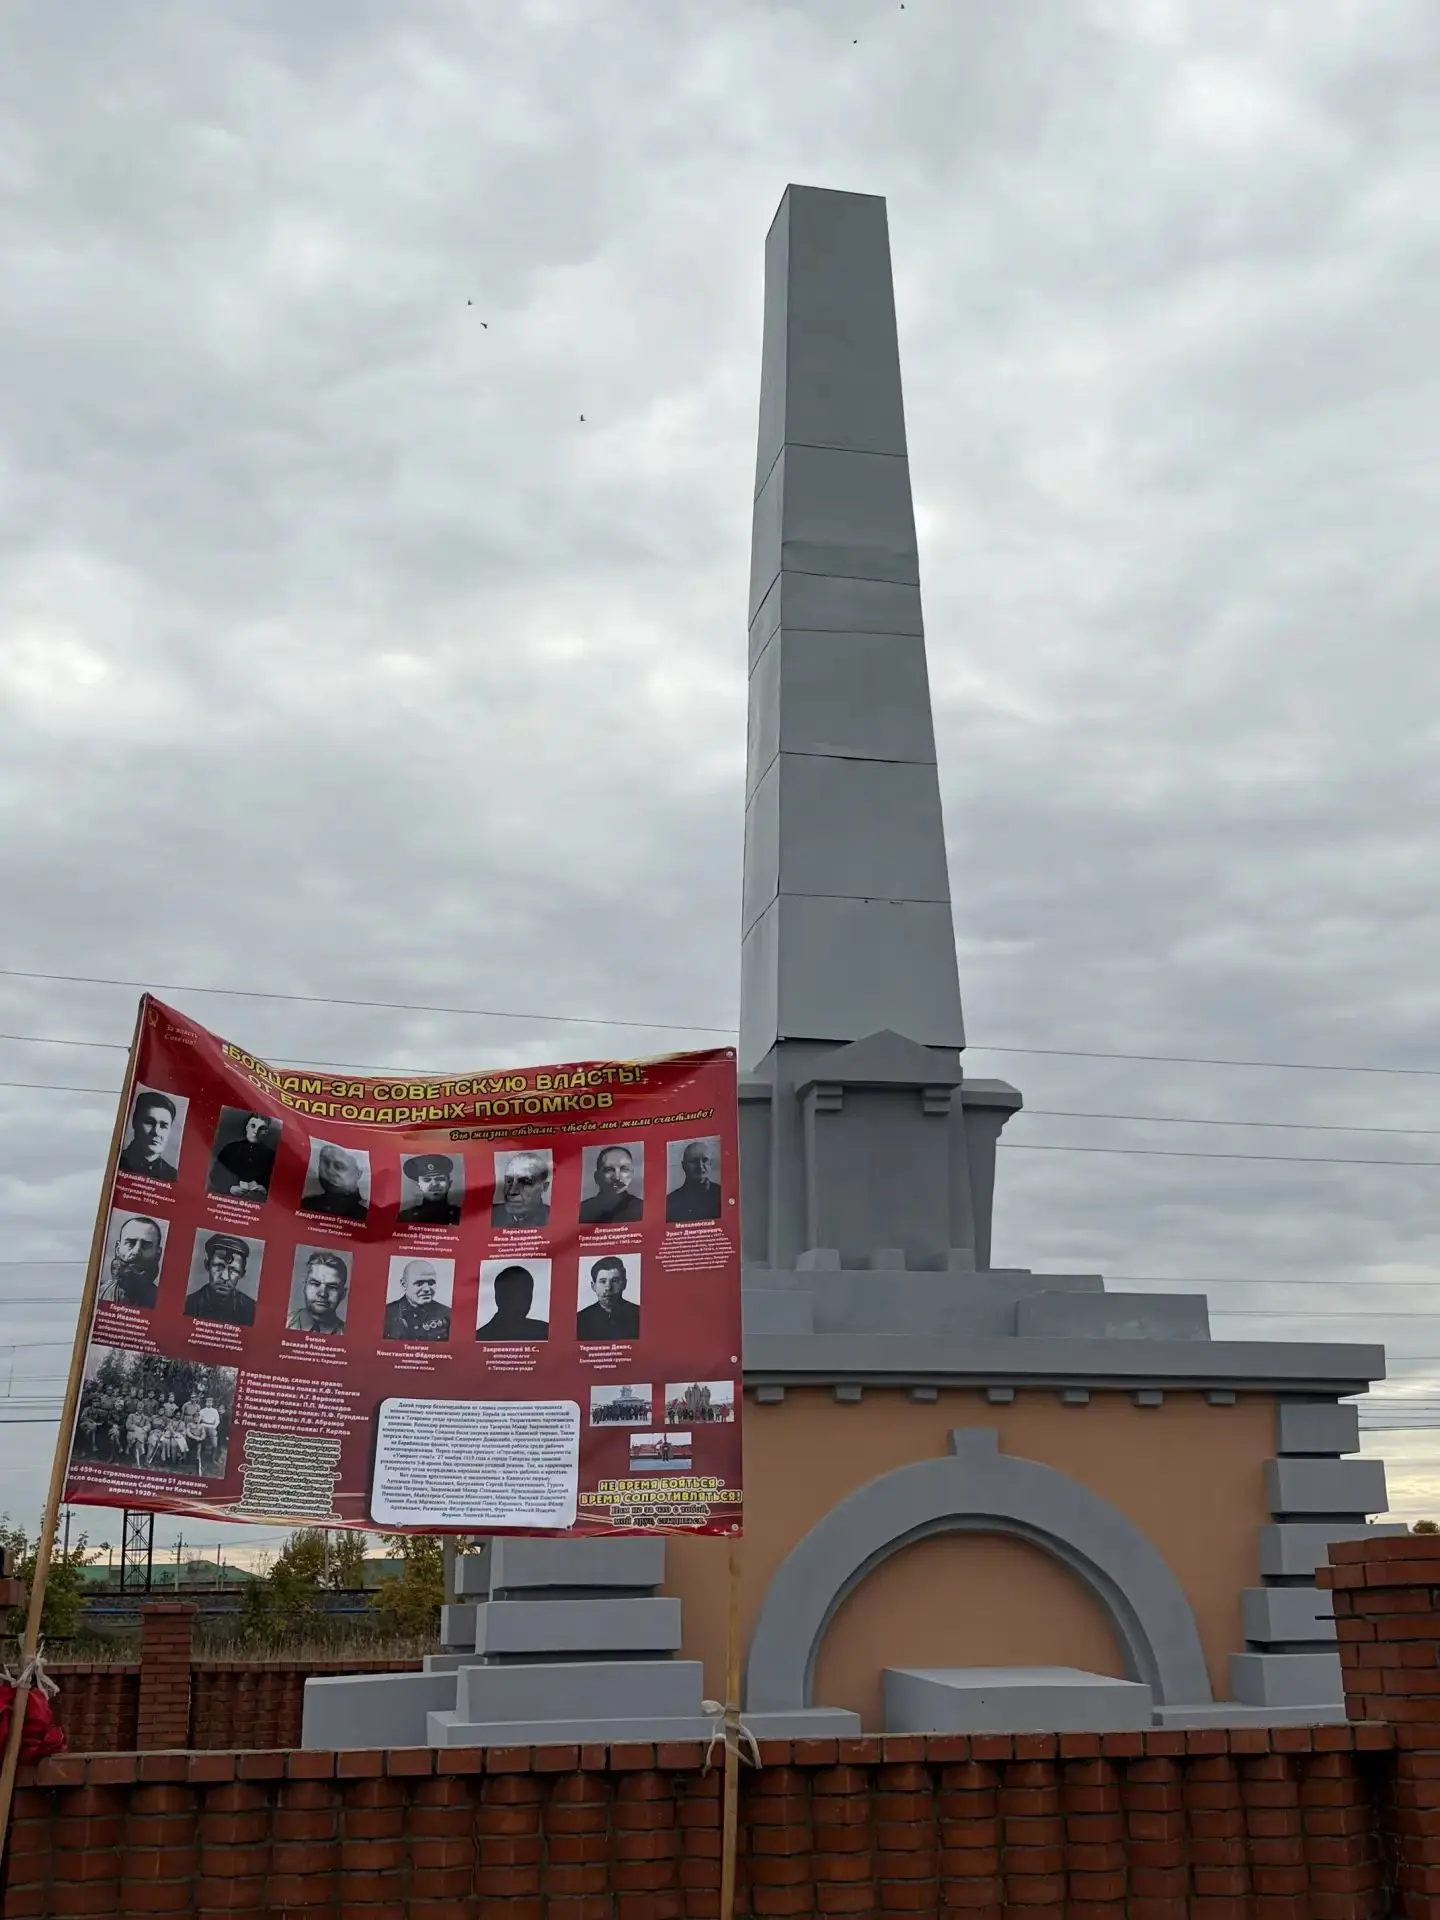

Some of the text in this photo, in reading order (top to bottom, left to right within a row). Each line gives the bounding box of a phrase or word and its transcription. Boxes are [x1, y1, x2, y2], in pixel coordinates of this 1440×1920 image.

[227, 1044, 641, 1101] БОРЦАМ ЗА СОВЕТСКУЮ ВЛАСТЬ!
[248, 1074, 614, 1123] ОТ БЛАГОДАРНЫХ ПОТОМКОВ
[450, 1130, 469, 1141] Вы
[472, 1129, 508, 1141] жизни
[562, 1121, 597, 1134] чтобы
[600, 1120, 618, 1130] мы
[621, 1117, 651, 1128] жили
[654, 1109, 714, 1125] счастливо!
[138, 1482, 165, 1492] Сибири
[599, 1482, 616, 1492] НЕ
[617, 1480, 658, 1491] ВРЕМЯ
[660, 1479, 717, 1490] БОЯТЬСЯ
[580, 1494, 620, 1505] ВРЕМЯ
[623, 1491, 742, 1504] СОПРОТИВЛЯТЬСЯ!
